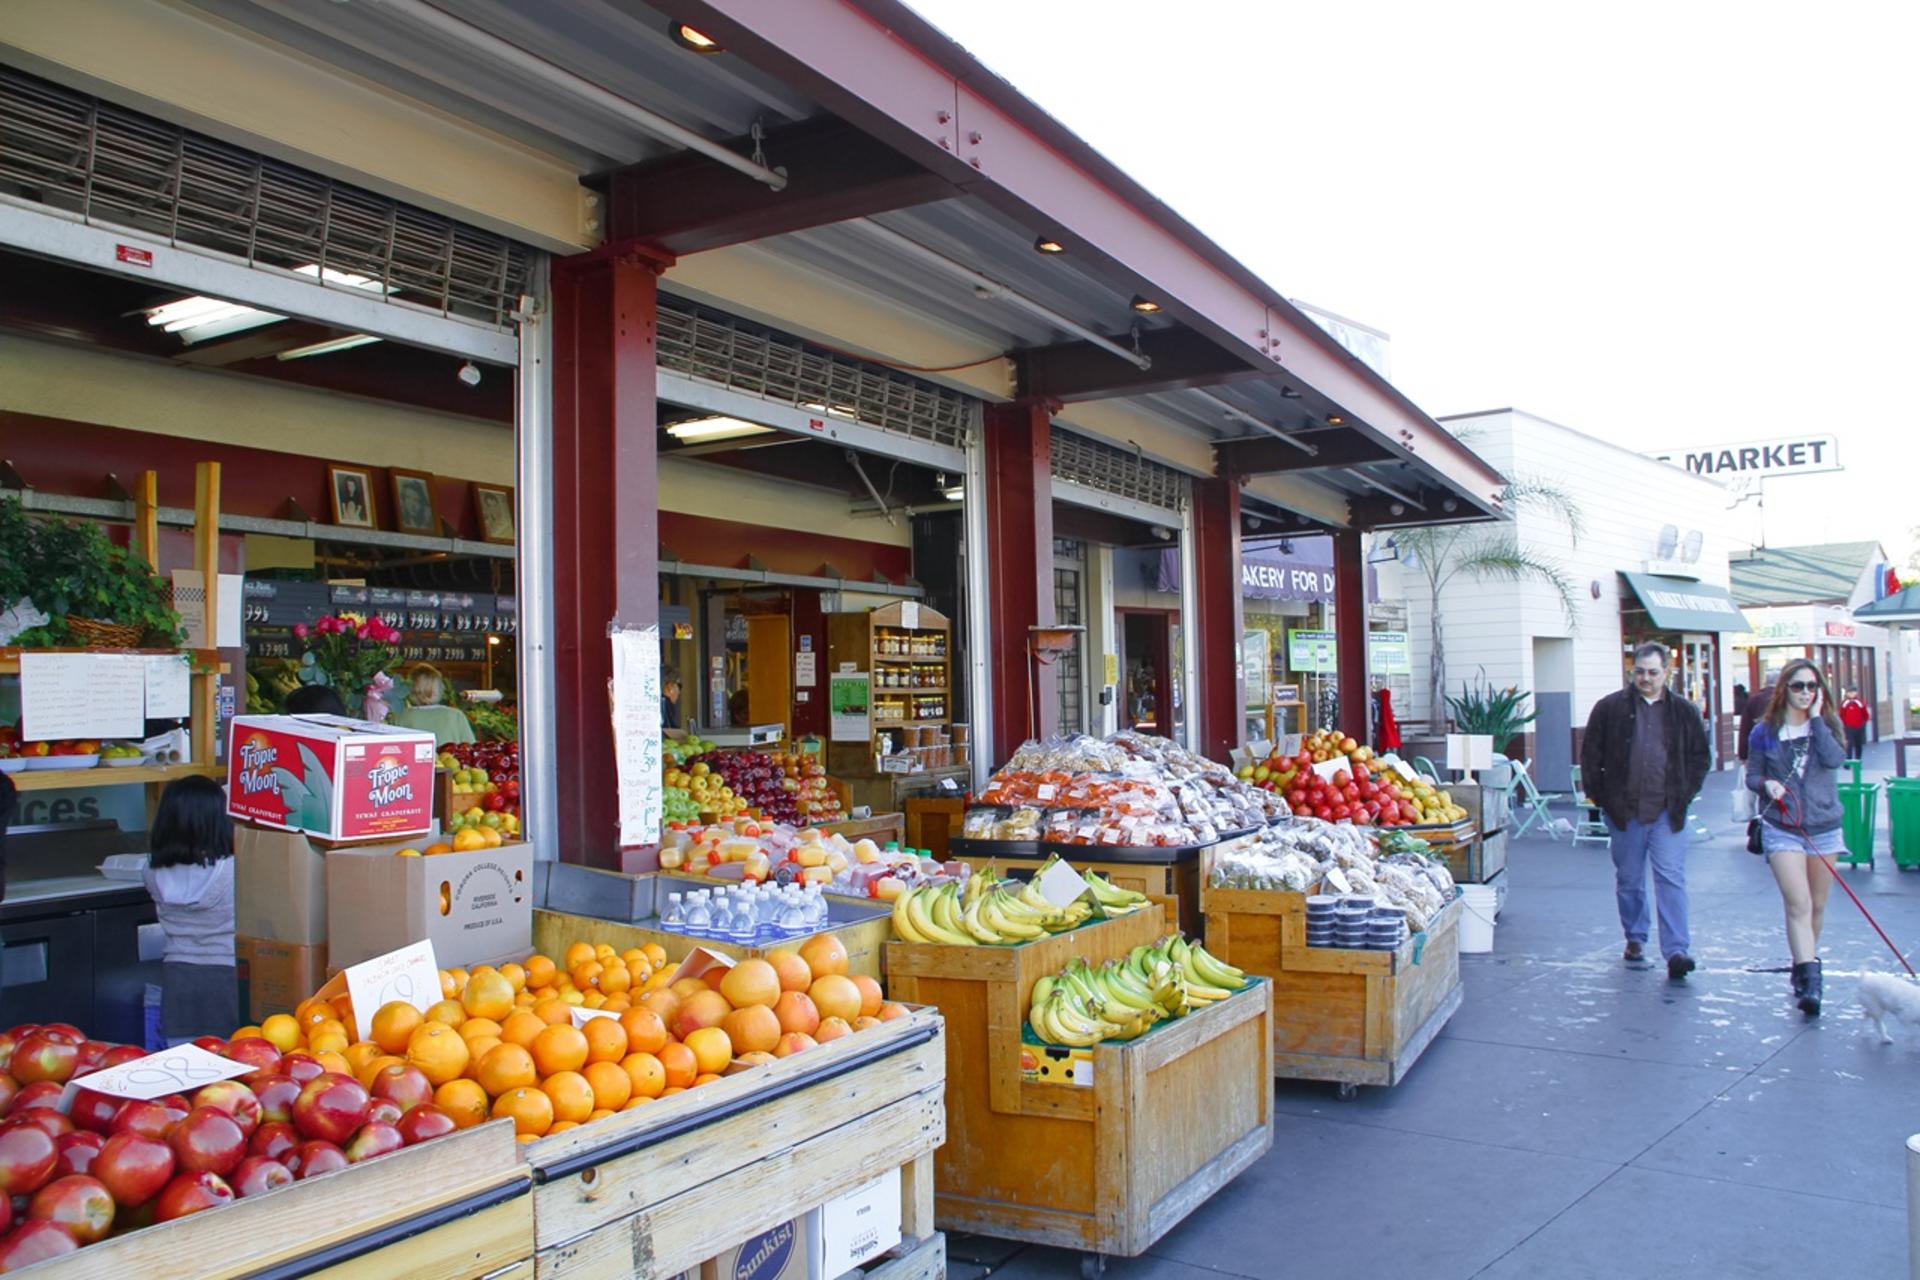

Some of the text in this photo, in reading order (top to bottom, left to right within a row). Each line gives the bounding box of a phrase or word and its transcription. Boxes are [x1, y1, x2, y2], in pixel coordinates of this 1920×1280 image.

[1685, 440, 1827, 475] MARKET
[1242, 564, 1285, 589] AKERY
[1291, 570, 1318, 593] FOR
[240, 740, 278, 767] Tropic
[240, 768, 280, 795] Moon
[368, 762, 408, 788] Tropic
[368, 783, 413, 808] Moon
[473, 862, 497, 873] COLLEGE
[737, 1224, 793, 1280] Sunkist
